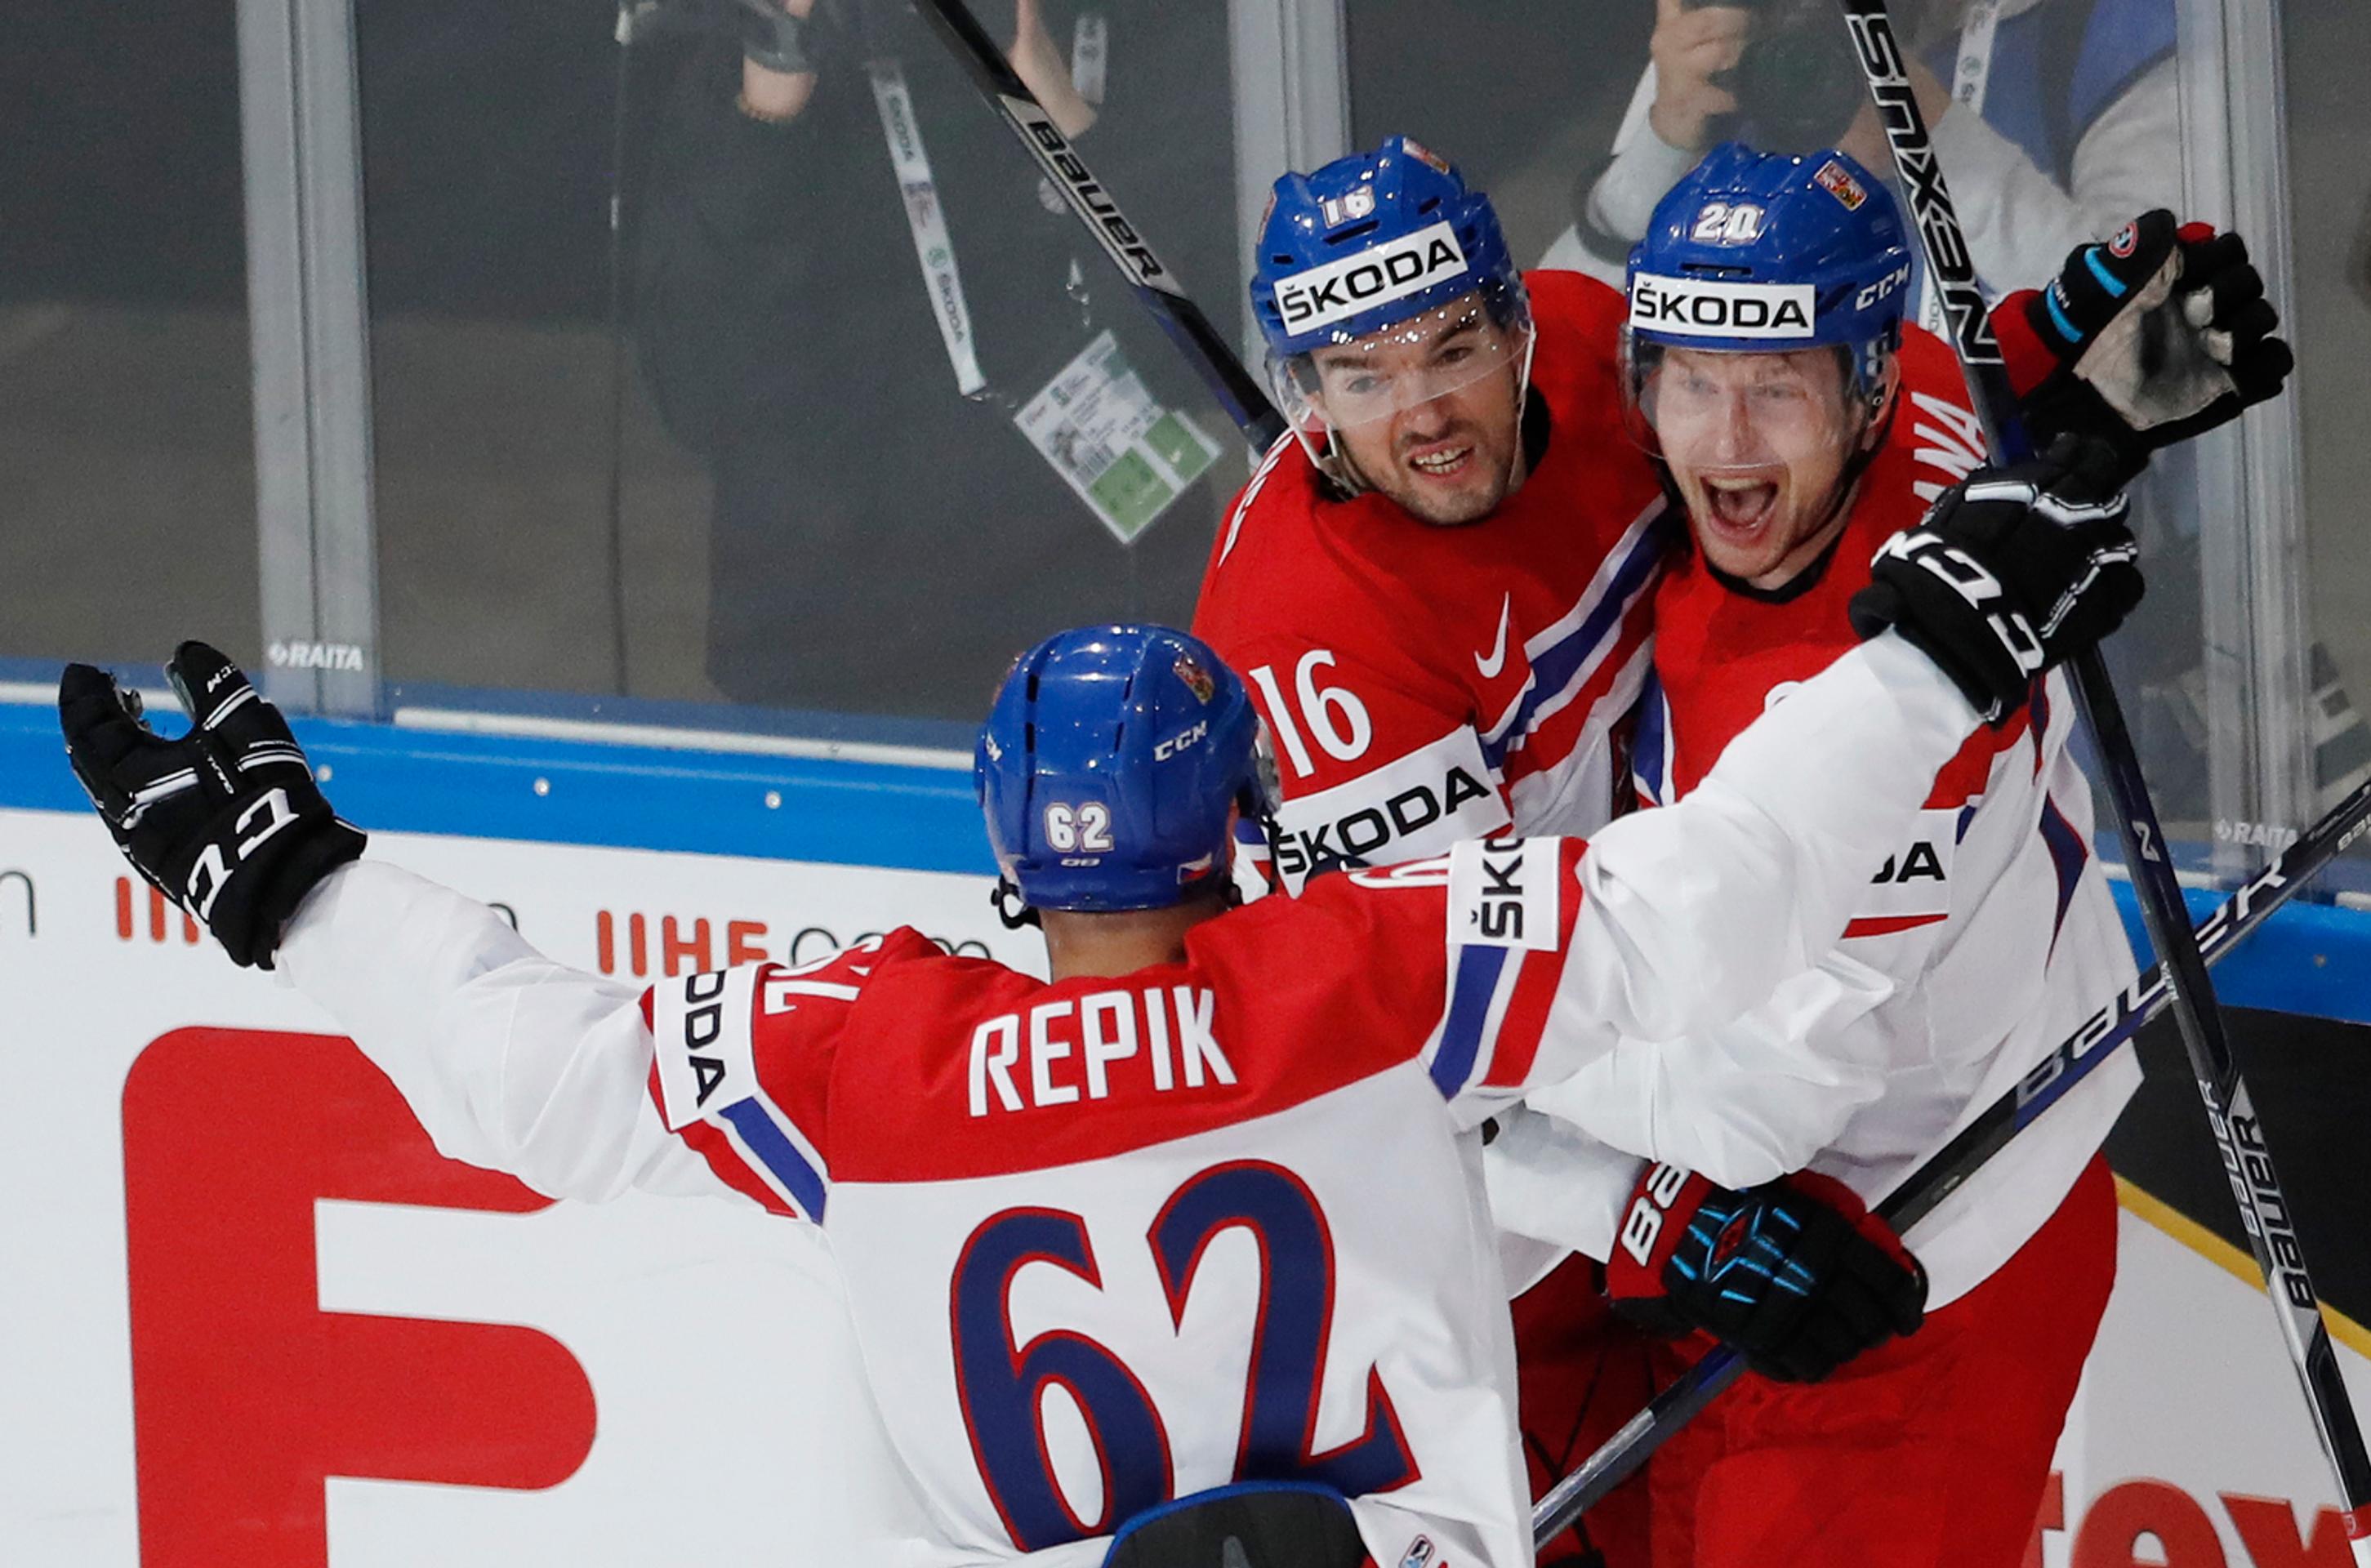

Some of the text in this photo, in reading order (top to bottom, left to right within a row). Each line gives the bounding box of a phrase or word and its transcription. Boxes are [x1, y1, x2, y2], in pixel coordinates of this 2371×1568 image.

[1321, 185, 1377, 229] 16
[1845, 11, 2003, 364] NEXUS
[1689, 201, 1766, 243] 20
[1282, 238, 1462, 323] ŠKODA
[1634, 279, 1810, 328] ŠKODA
[1856, 262, 1912, 311] CCM
[289, 643, 364, 672] RAITA
[1249, 649, 1373, 778] 16
[1153, 719, 1209, 763] CCM
[1044, 800, 1114, 853] 62
[969, 985, 1237, 1118] REPIK
[950, 1157, 1422, 1553] 62
